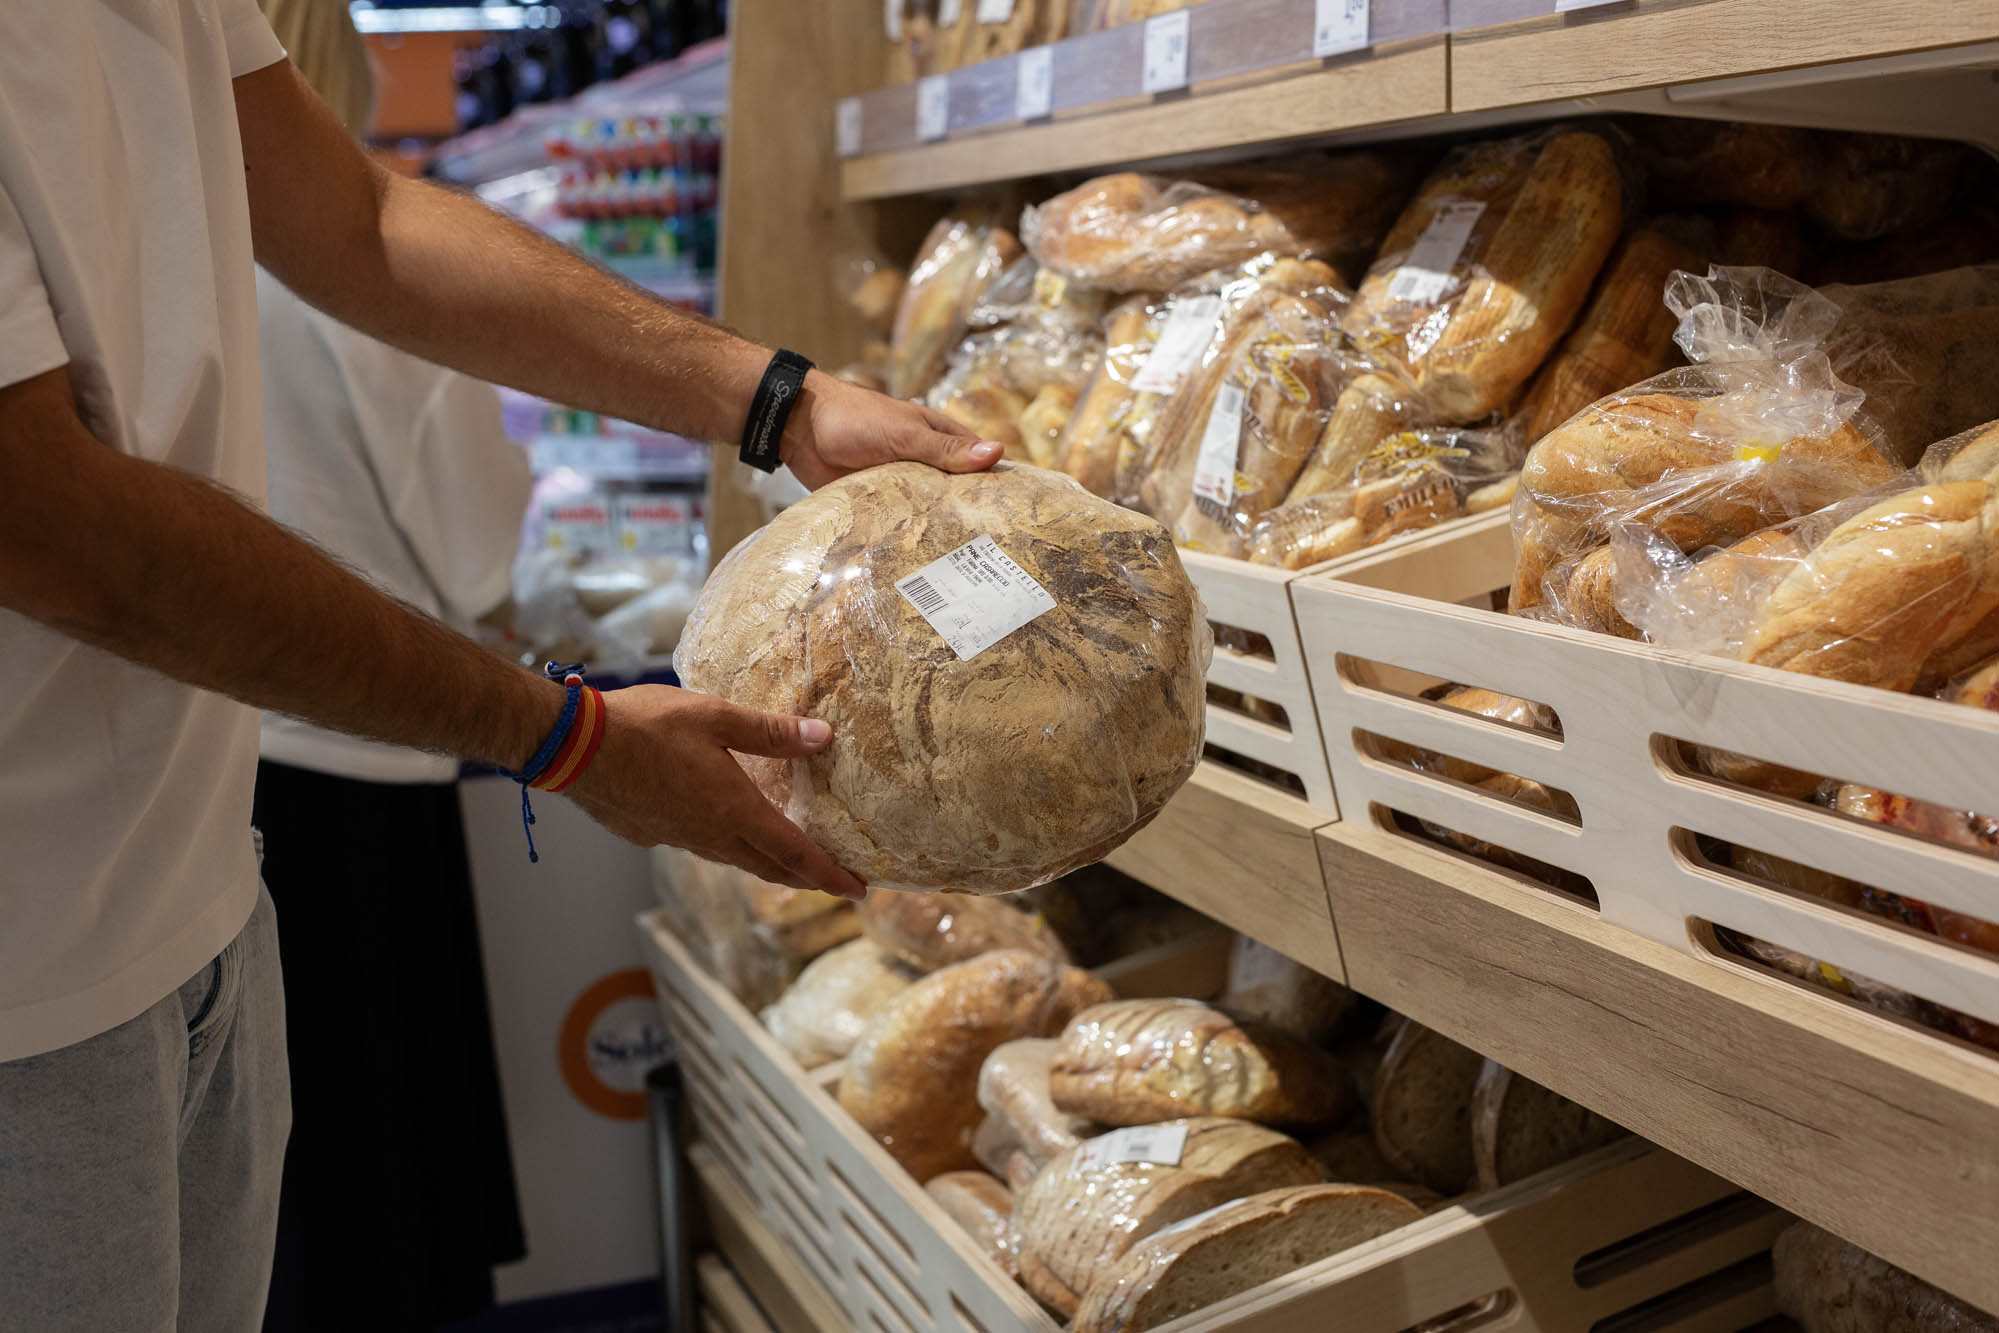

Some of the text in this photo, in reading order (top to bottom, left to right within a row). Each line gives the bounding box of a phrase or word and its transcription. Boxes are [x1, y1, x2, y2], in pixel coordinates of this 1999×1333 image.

[965, 543, 981, 561] PANE
[979, 559, 1010, 587] CASARECCIO
[984, 541, 995, 554] IL
[997, 554, 1045, 597] CASTELLO
